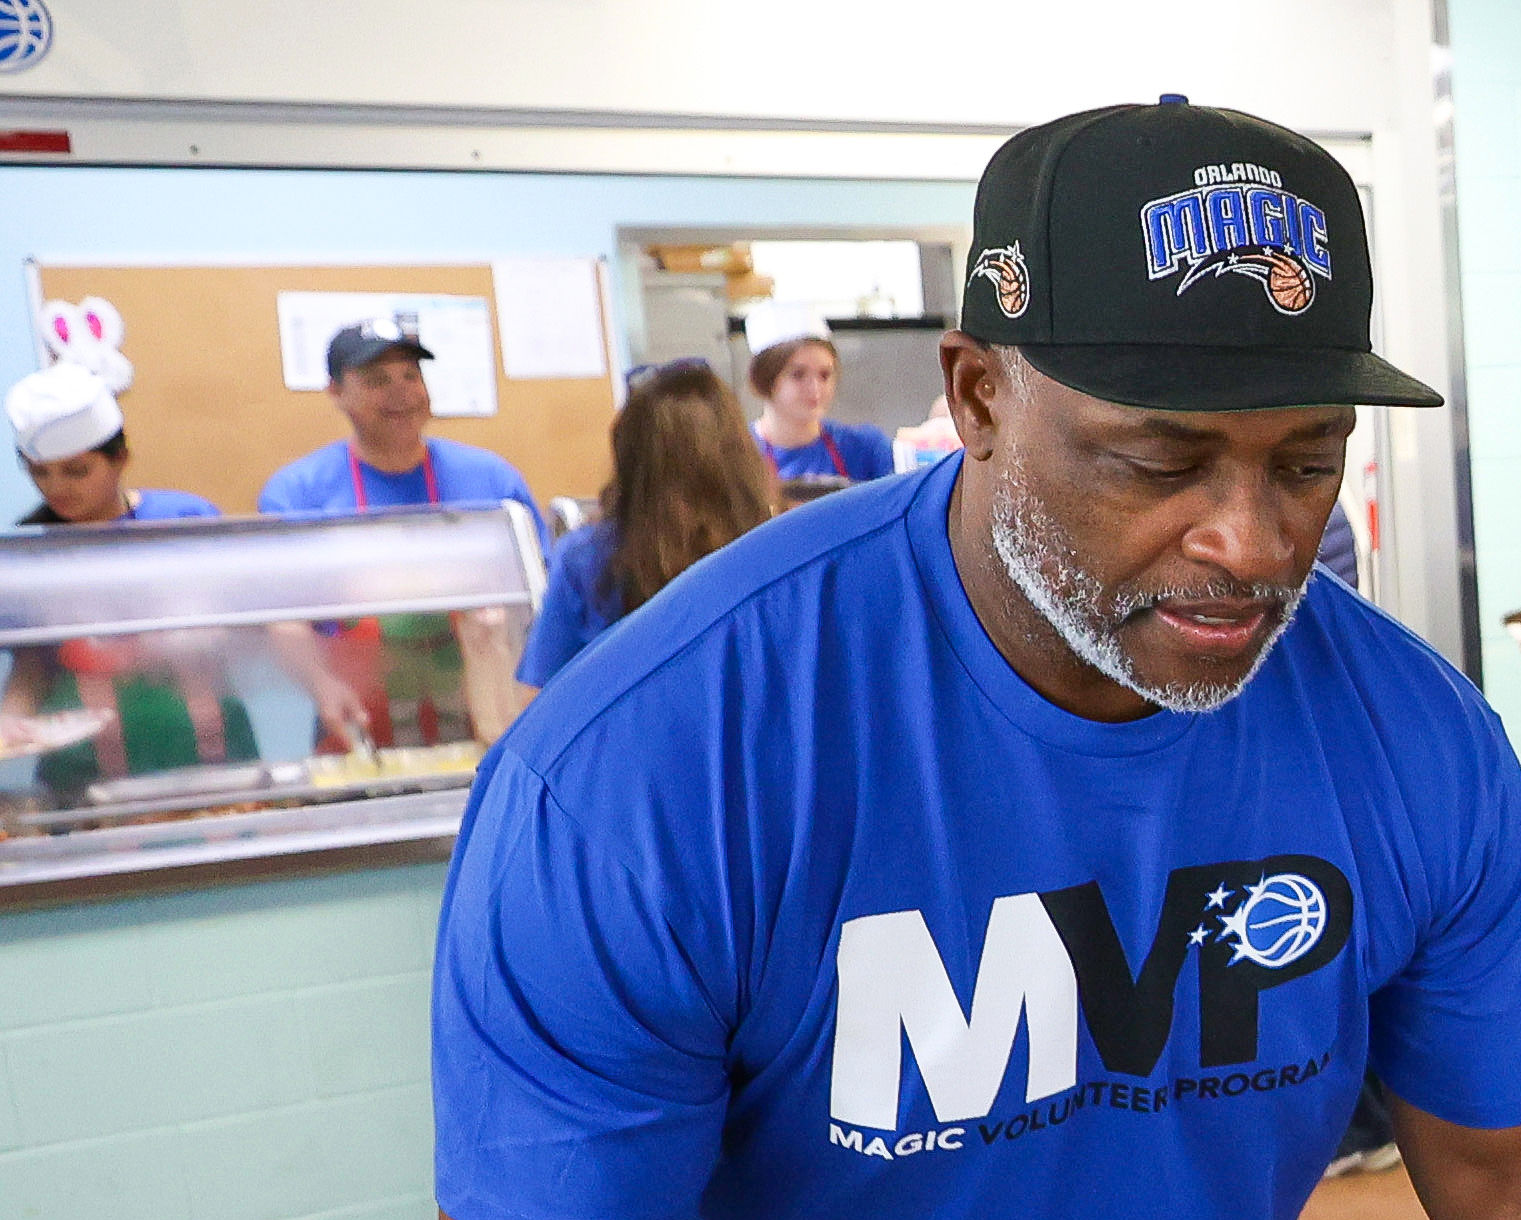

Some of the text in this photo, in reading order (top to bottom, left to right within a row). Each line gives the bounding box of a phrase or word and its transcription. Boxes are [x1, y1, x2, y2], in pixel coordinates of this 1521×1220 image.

[1194, 162, 1283, 188] ORLANDO
[1141, 182, 1332, 282] MAGIC
[830, 854, 1354, 1131] MVP
[829, 1123, 966, 1160] MAGIC
[978, 1082, 1168, 1145] VOLUNTEER
